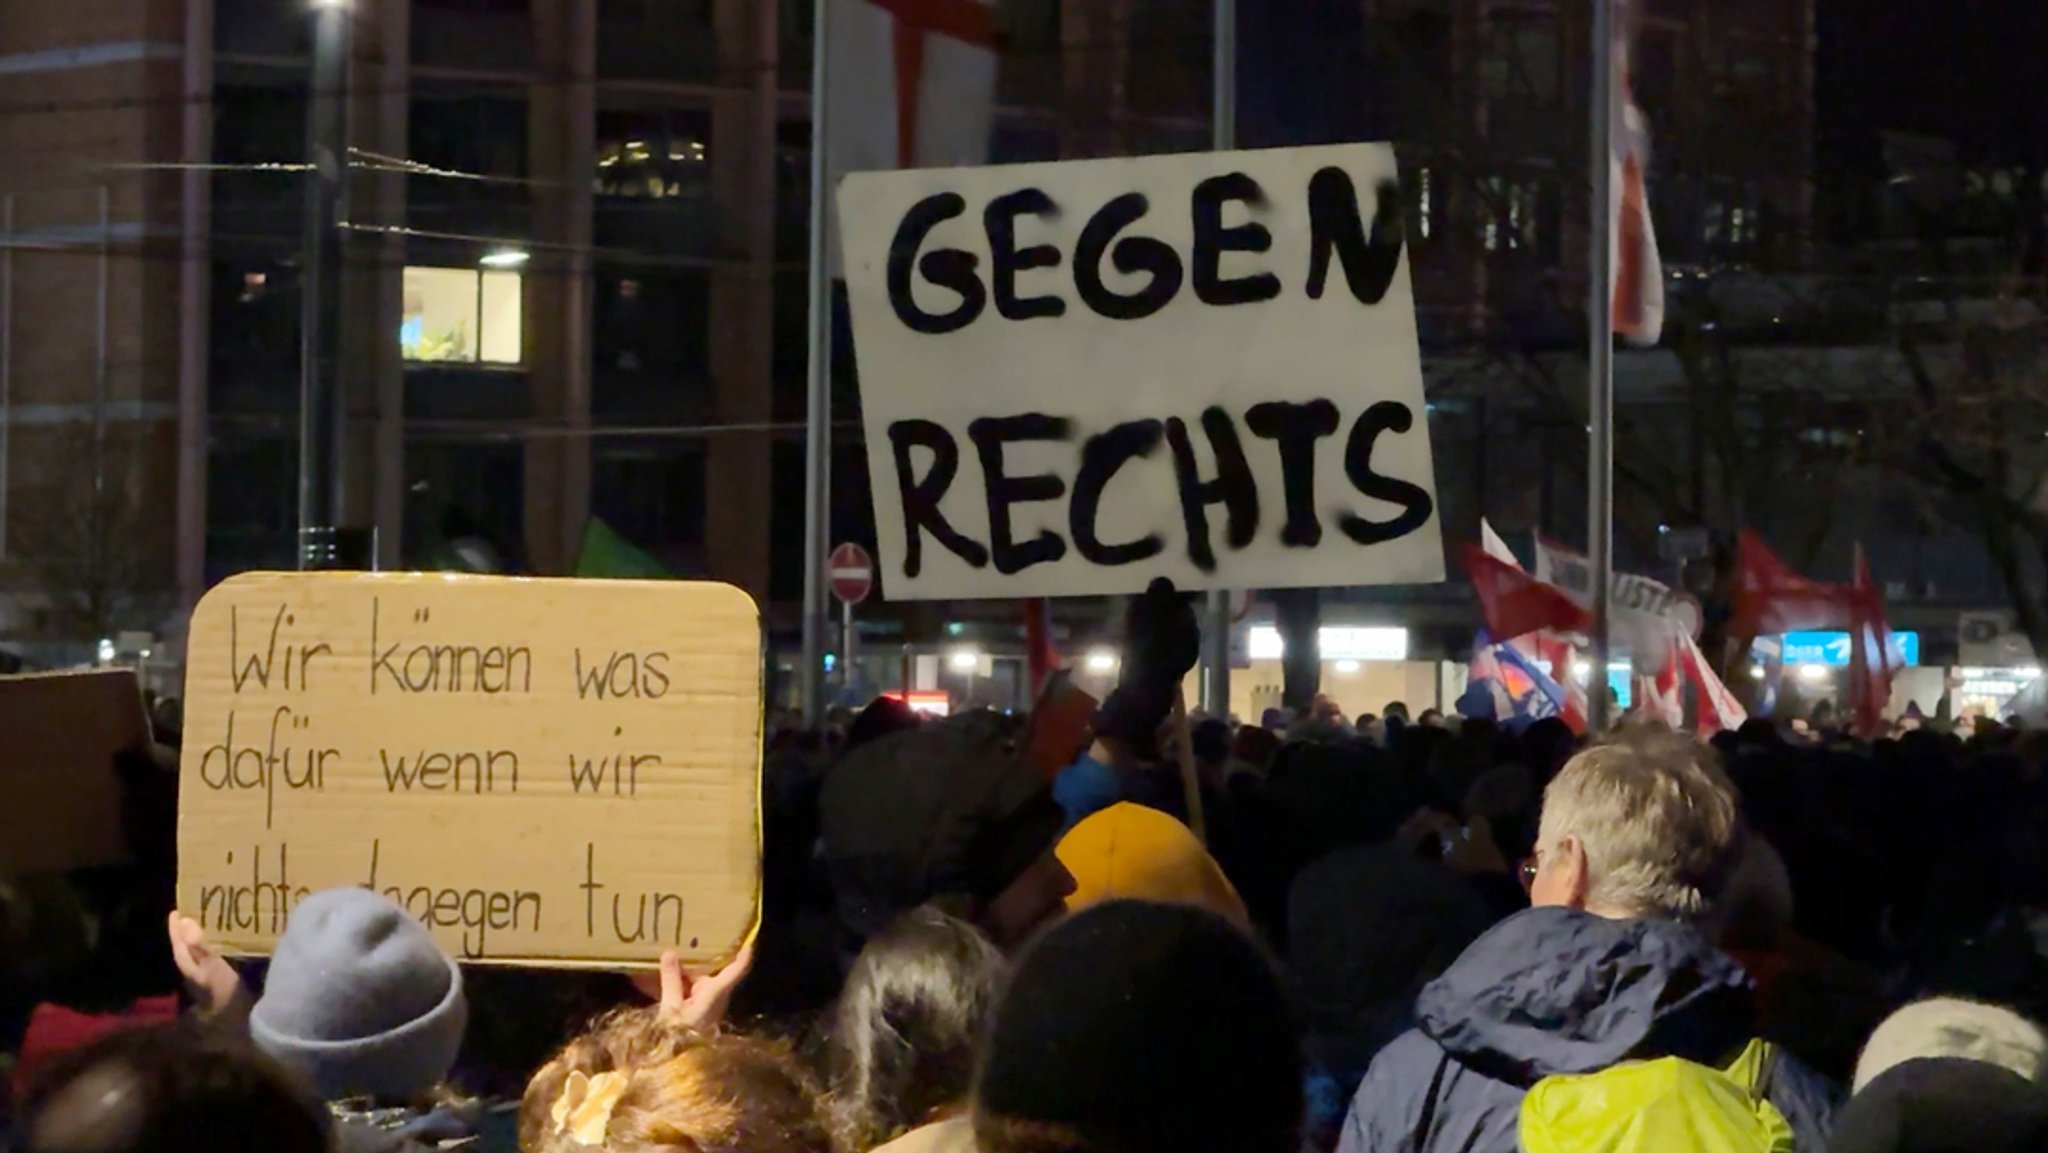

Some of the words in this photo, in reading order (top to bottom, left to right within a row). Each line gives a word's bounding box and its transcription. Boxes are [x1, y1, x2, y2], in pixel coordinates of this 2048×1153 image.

[887, 165, 1405, 334] GEGEN
[888, 398, 1433, 579] RECHTS
[231, 603, 333, 694] Wir
[371, 597, 531, 695] können
[574, 648, 671, 701] was
[200, 706, 340, 829] dafür
[379, 748, 519, 795] wenn
[569, 726, 662, 796] wir
[579, 842, 700, 949] tun.
